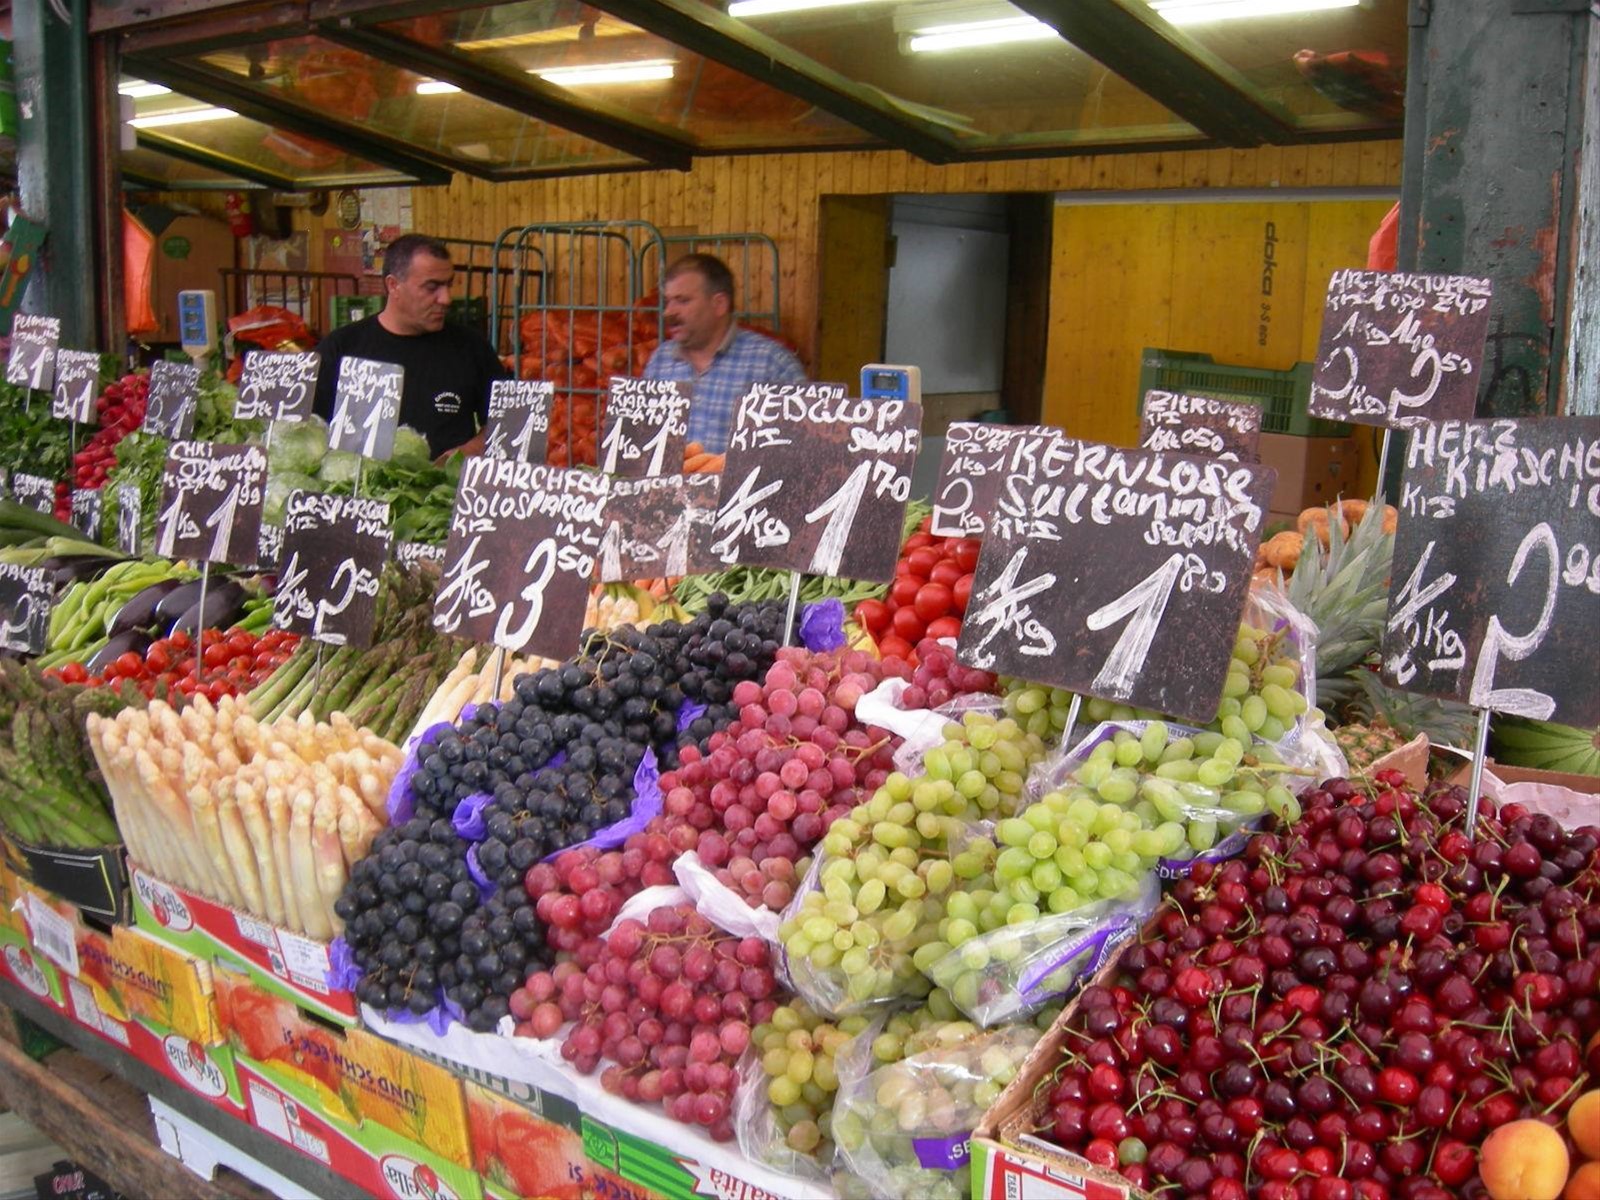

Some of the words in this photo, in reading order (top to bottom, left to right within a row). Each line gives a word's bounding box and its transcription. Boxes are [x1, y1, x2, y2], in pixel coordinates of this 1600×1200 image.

[1262, 221, 1279, 296] doka
[610, 376, 679, 396] ZUCKER
[1407, 418, 1519, 470] HERZ
